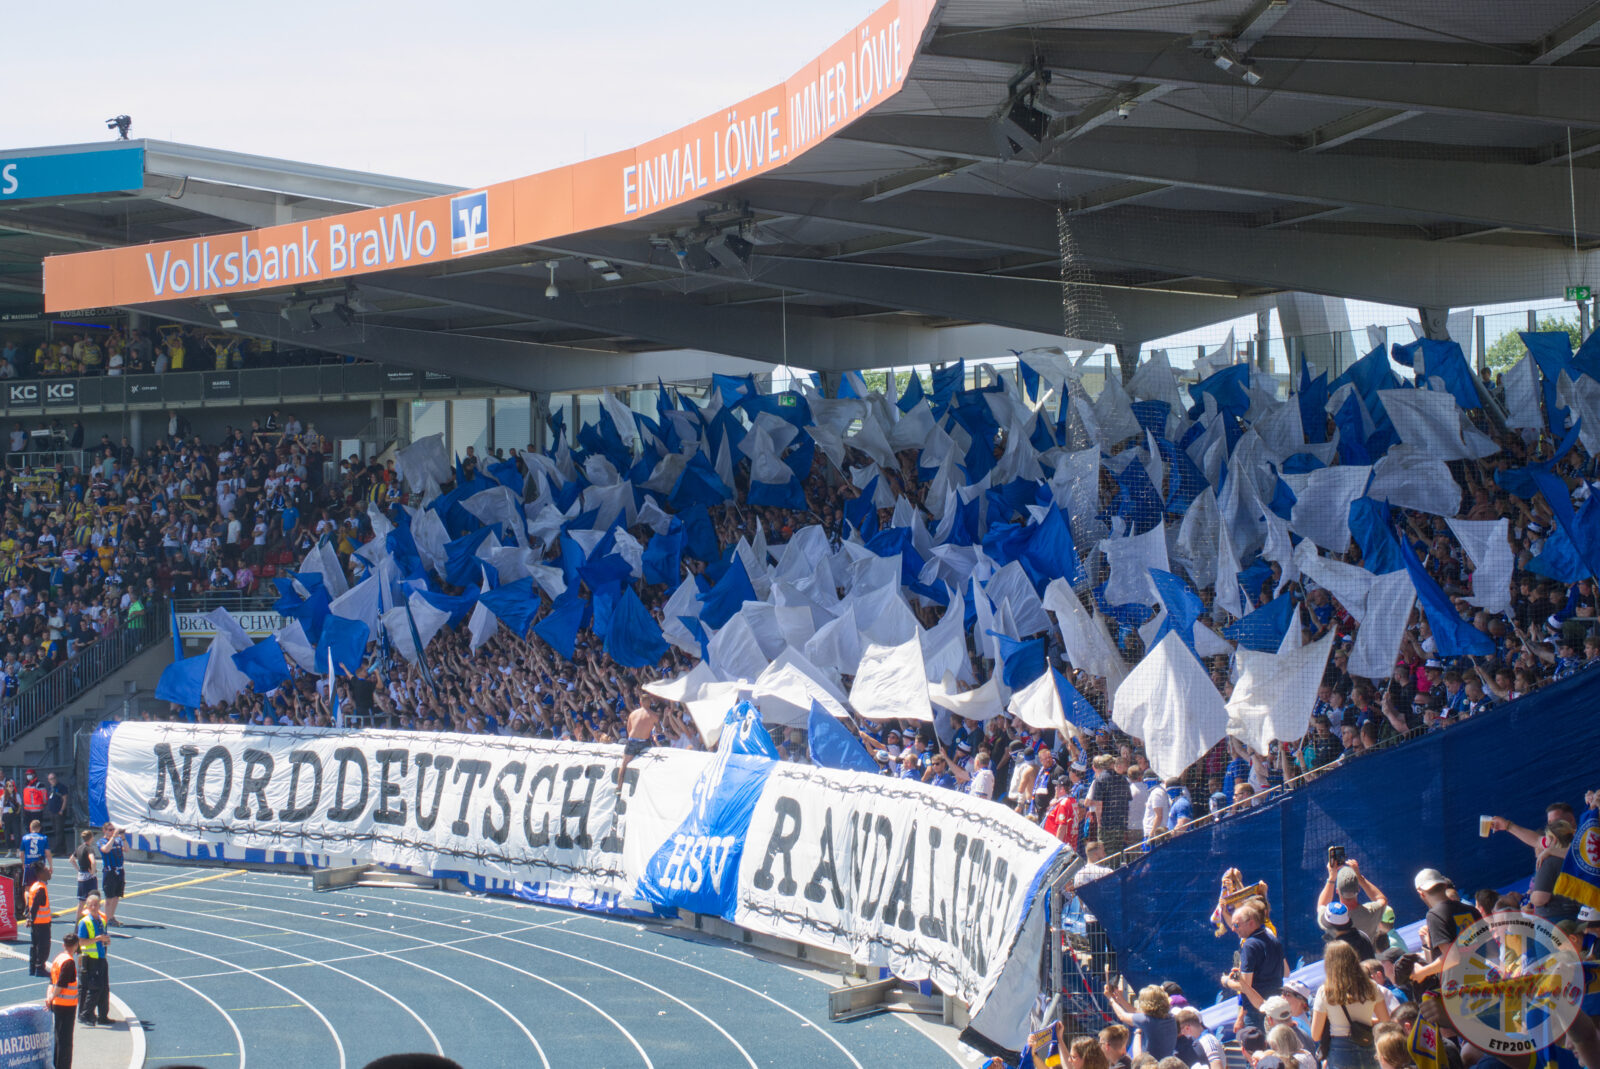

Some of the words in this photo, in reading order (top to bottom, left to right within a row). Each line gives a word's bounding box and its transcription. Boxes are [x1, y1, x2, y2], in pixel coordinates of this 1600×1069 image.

[623, 138, 708, 215] EINMAL
[714, 106, 788, 184] LÖWE.
[790, 60, 848, 152] IMMER
[851, 17, 903, 112] LÖWE
[145, 225, 319, 296] Volksbank
[329, 210, 437, 272] BraWo
[10, 385, 37, 399] KC
[47, 384, 74, 397] KC
[148, 743, 639, 854] NORDDEUTSCHE
[659, 833, 735, 895] HSV
